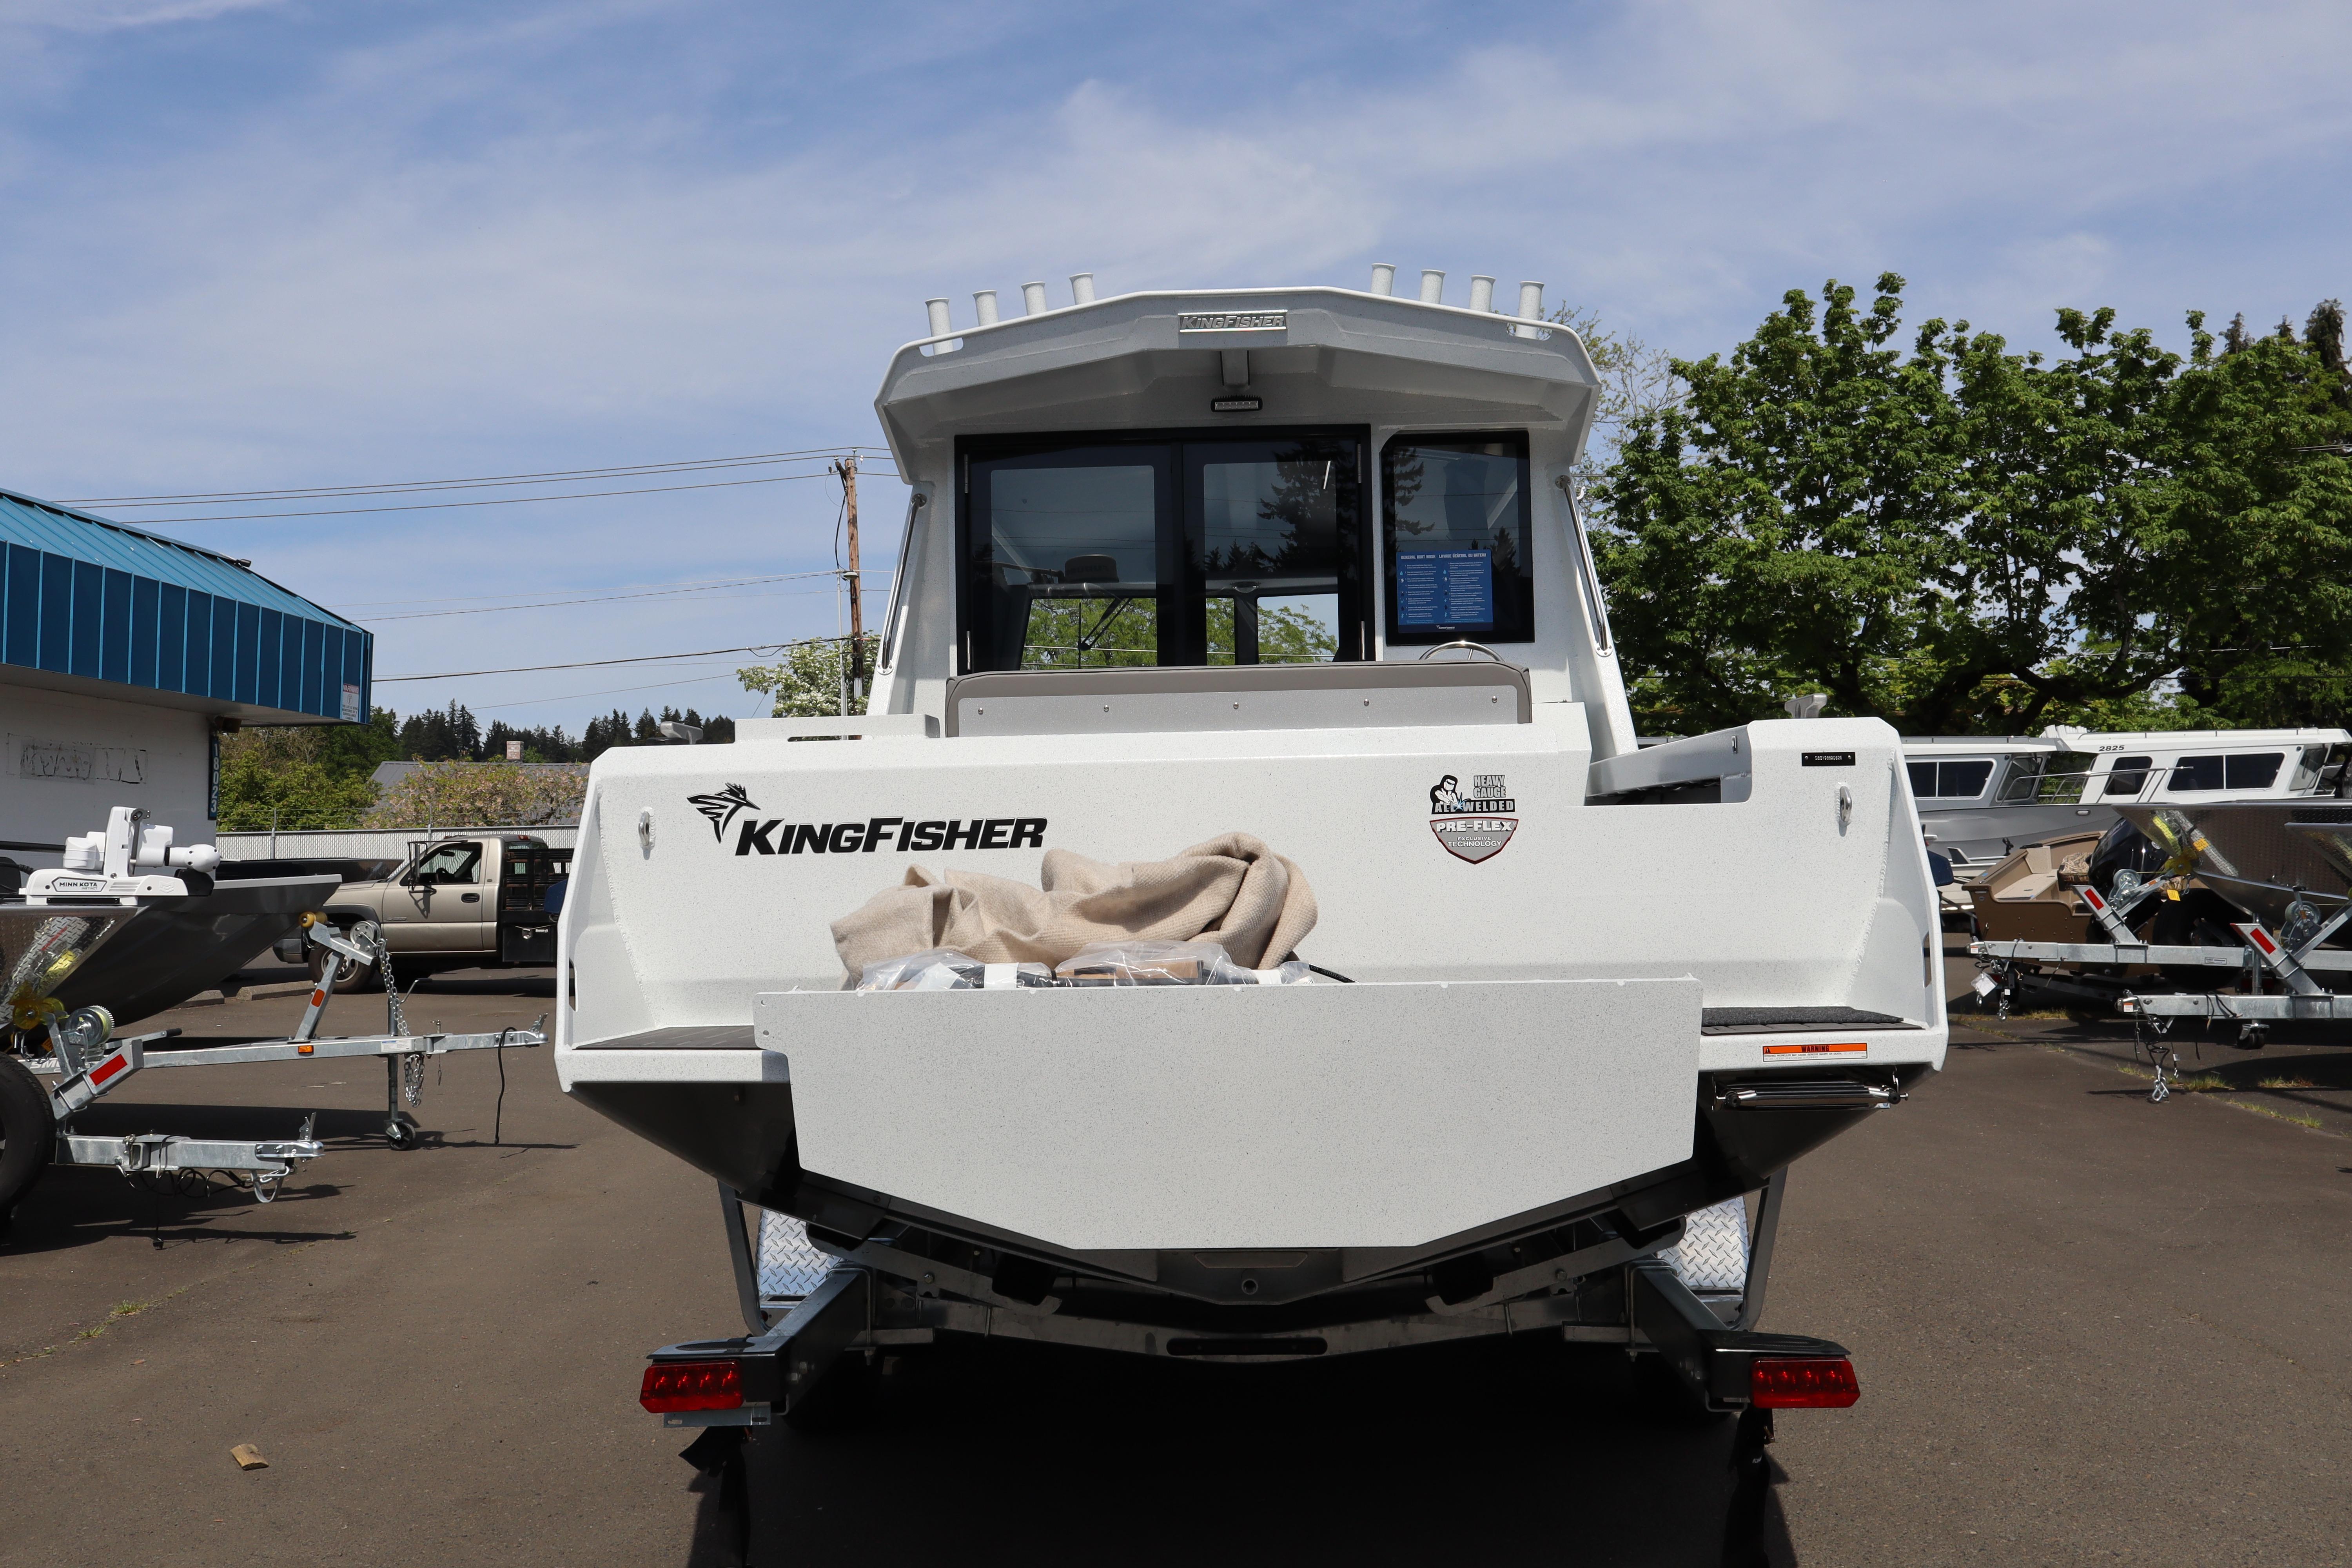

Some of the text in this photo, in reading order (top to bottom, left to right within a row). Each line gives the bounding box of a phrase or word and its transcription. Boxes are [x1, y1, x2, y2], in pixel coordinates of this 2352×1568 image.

[211, 744, 219, 813] 18023
[1474, 775, 1505, 786] HEAVY
[1473, 786, 1506, 798] GAUGE
[1434, 800, 1514, 813] ALL WELDED
